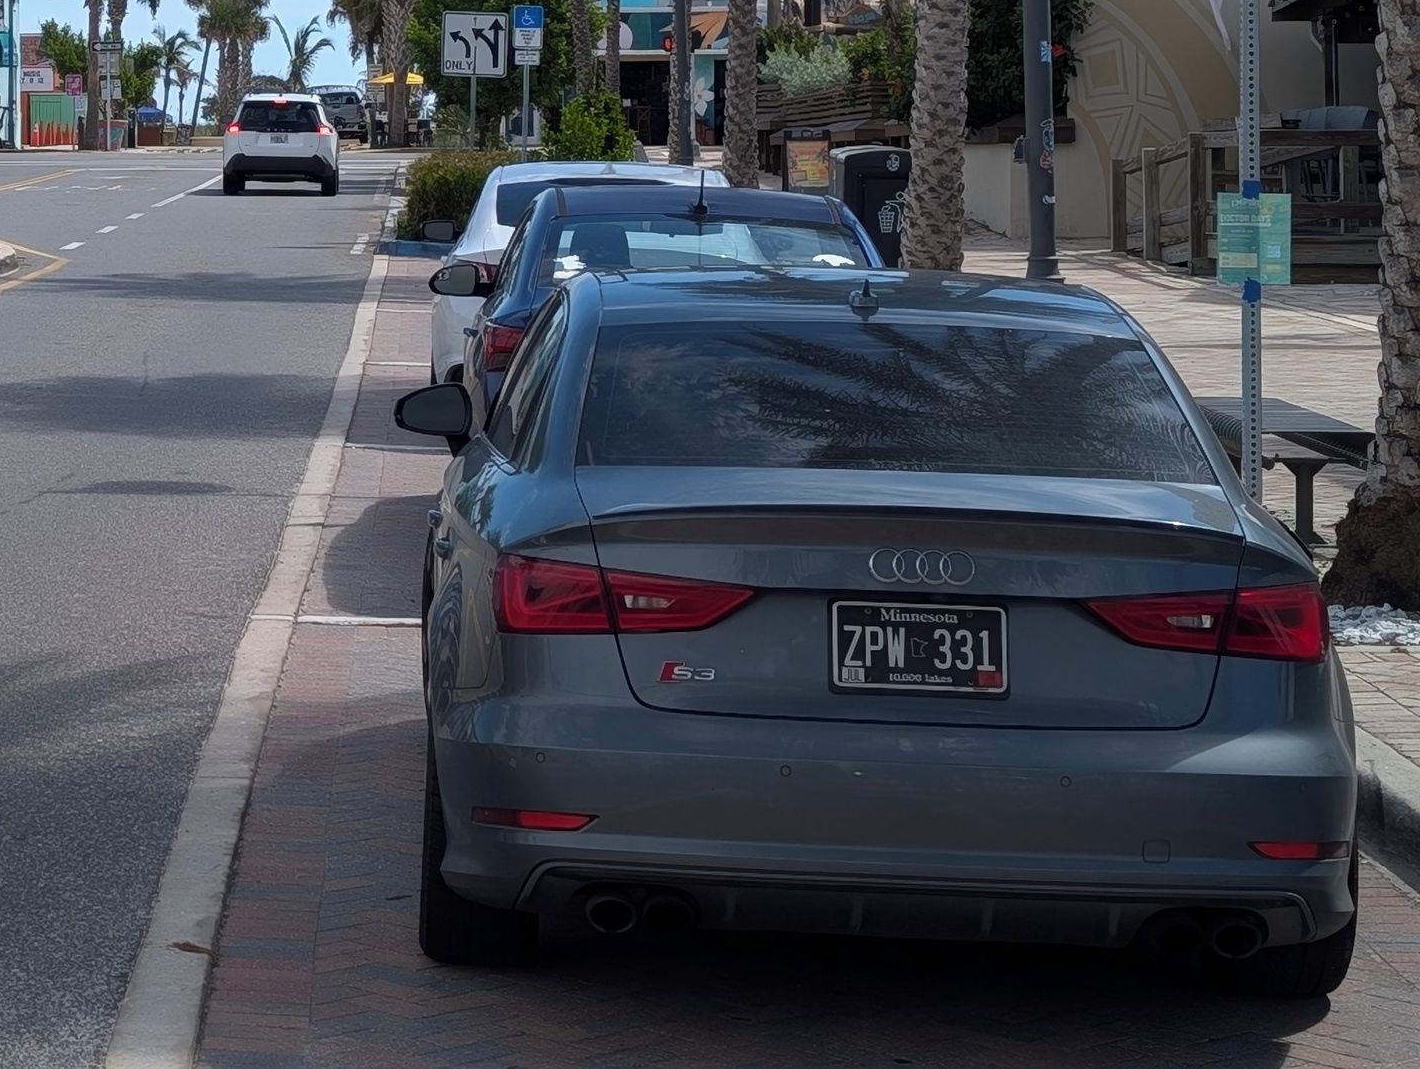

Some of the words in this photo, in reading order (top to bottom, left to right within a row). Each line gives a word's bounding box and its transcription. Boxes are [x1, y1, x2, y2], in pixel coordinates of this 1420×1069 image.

[445, 59, 473, 70] ONLY
[880, 608, 958, 624] Minnesota
[843, 625, 906, 668] ZPW
[933, 628, 996, 671] 331
[672, 666, 715, 681] S3
[844, 669, 863, 681] JUL
